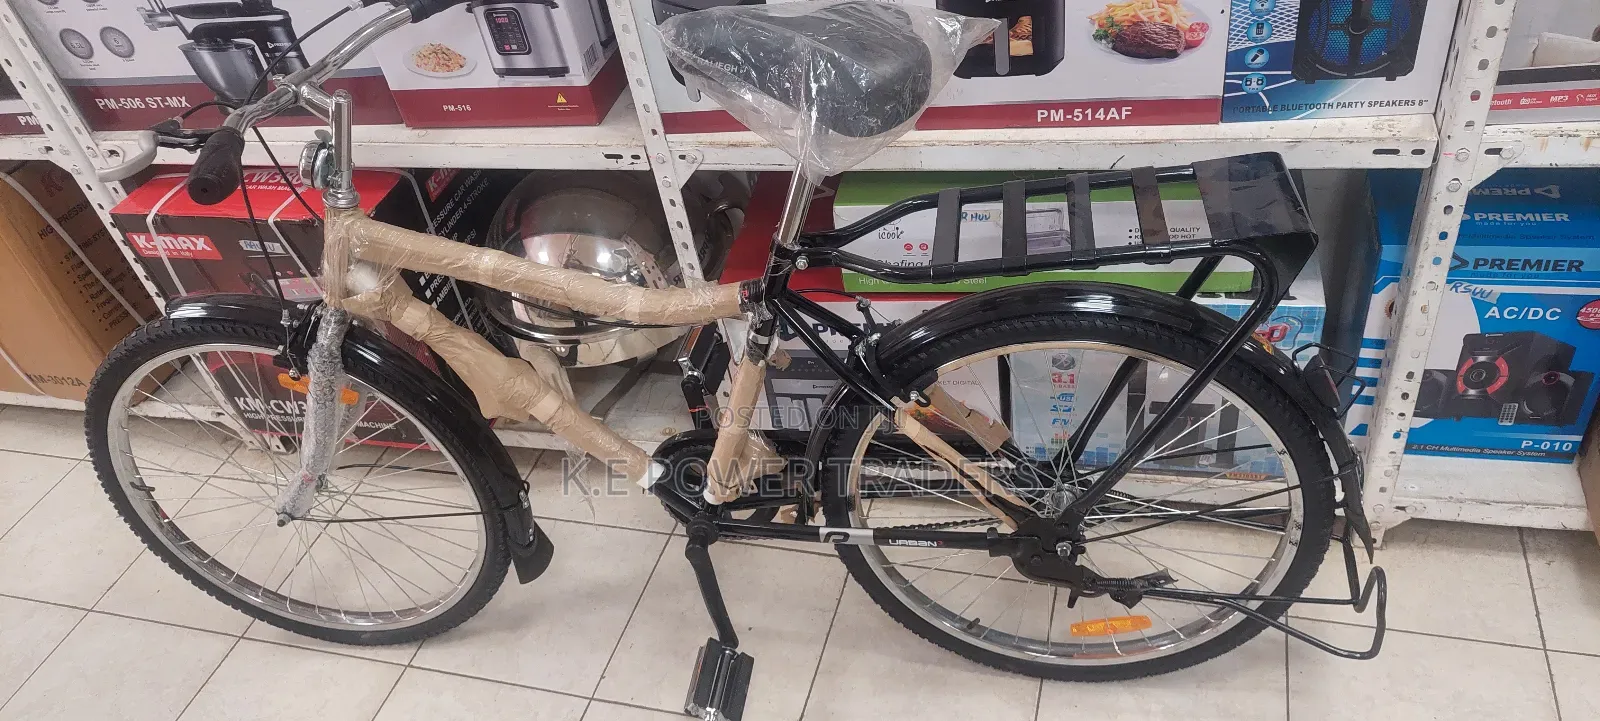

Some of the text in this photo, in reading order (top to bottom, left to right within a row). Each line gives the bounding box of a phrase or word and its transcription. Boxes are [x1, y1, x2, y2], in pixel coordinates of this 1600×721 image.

[95, 96, 192, 110] PM-506 ST-MX
[443, 104, 472, 112] PM-516
[1232, 105, 1280, 114] PORTABLE
[1280, 101, 1335, 112] BLUETOOTH
[1335, 100, 1366, 110] PARTY
[1367, 99, 1417, 108] SPEAKERS
[1037, 106, 1133, 122] PM-514AF
[1473, 212, 1571, 222] PREMIER
[1472, 257, 1585, 273] PREMIER
[858, 276, 880, 287] High
[962, 276, 987, 285] Steel
[1483, 306, 1562, 321] AC/DC
[1440, 445, 1481, 453] Multimedia
[1482, 448, 1515, 456] Speaker
[1520, 440, 1573, 451] P-010
